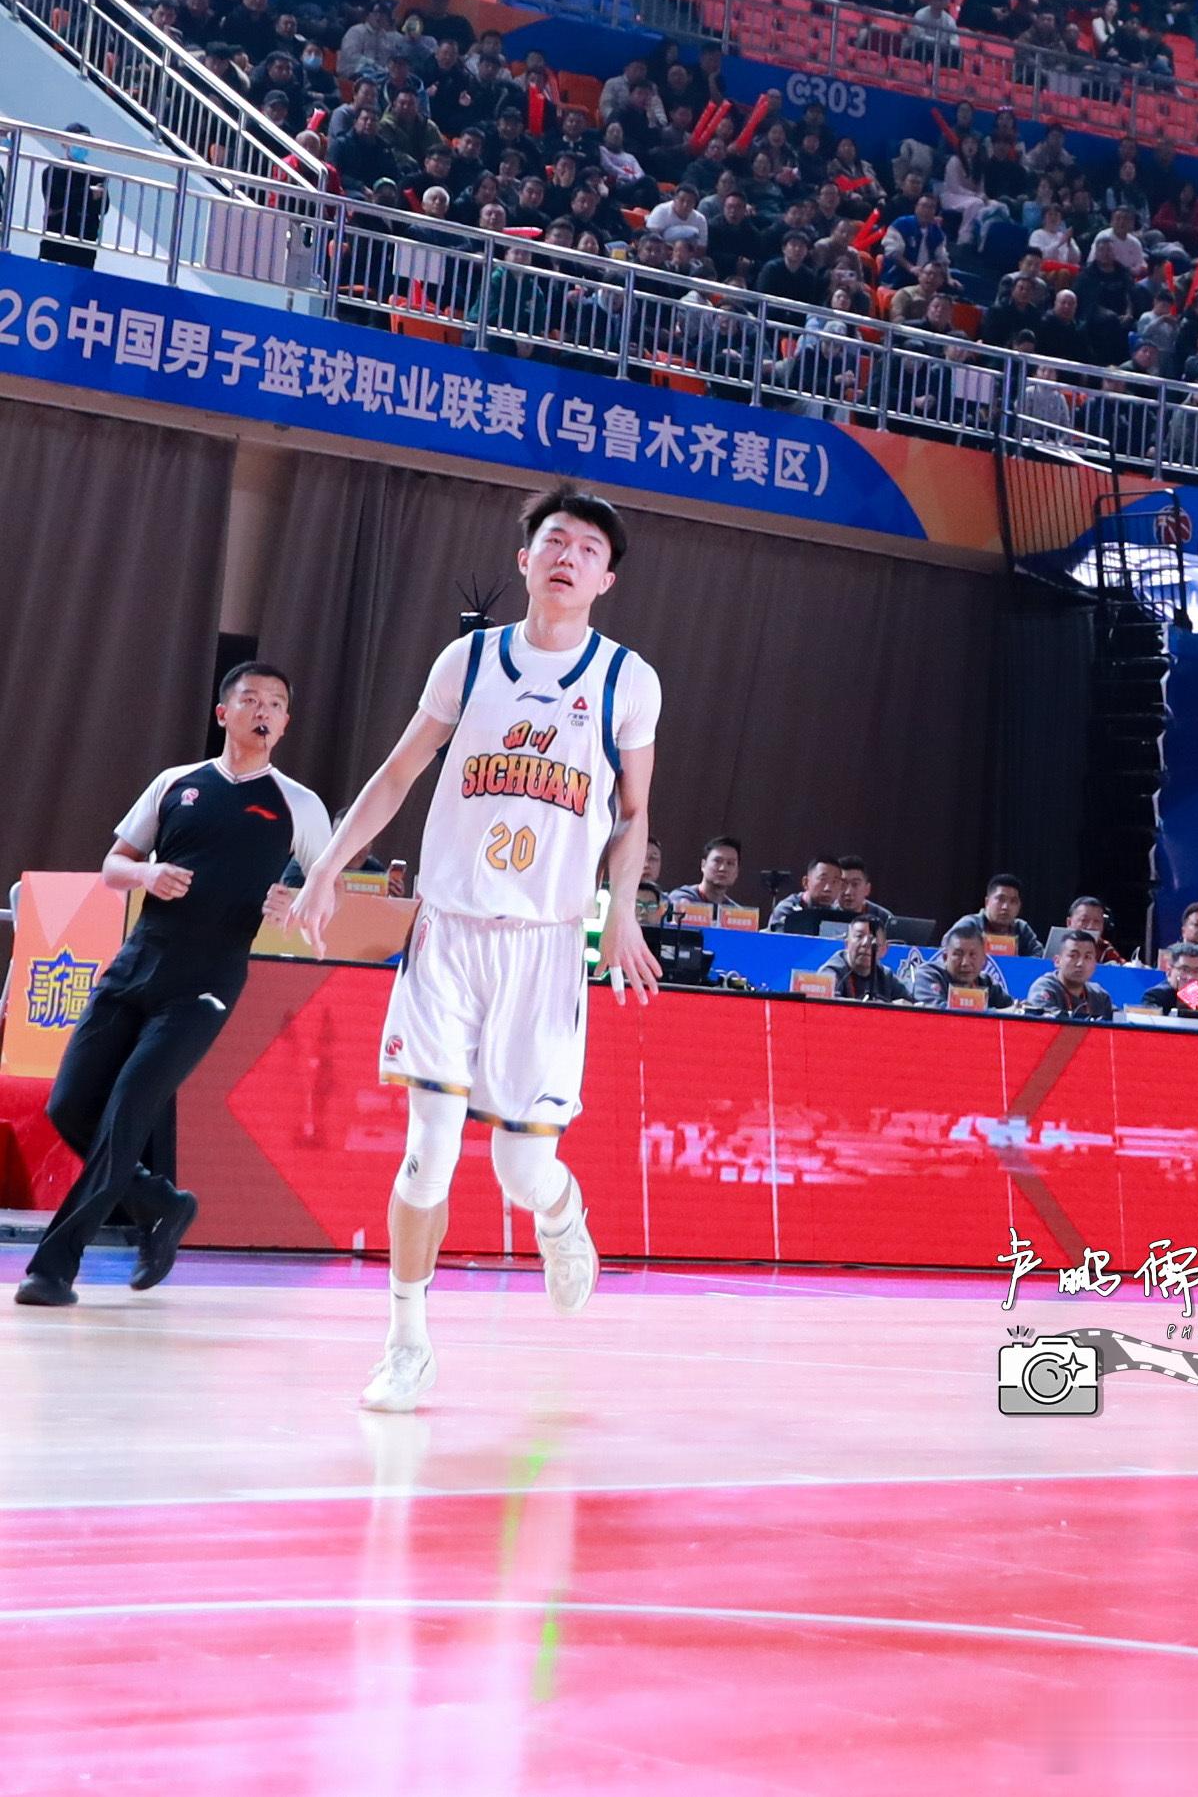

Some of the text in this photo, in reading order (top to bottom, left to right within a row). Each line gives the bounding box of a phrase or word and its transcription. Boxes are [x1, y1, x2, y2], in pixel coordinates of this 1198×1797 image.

[786, 72, 867, 118] C303
[503, 720, 558, 754] 四川
[461, 752, 591, 816] SICHUAN
[486, 821, 537, 873] 20
[31, 958, 97, 1027] 新疆
